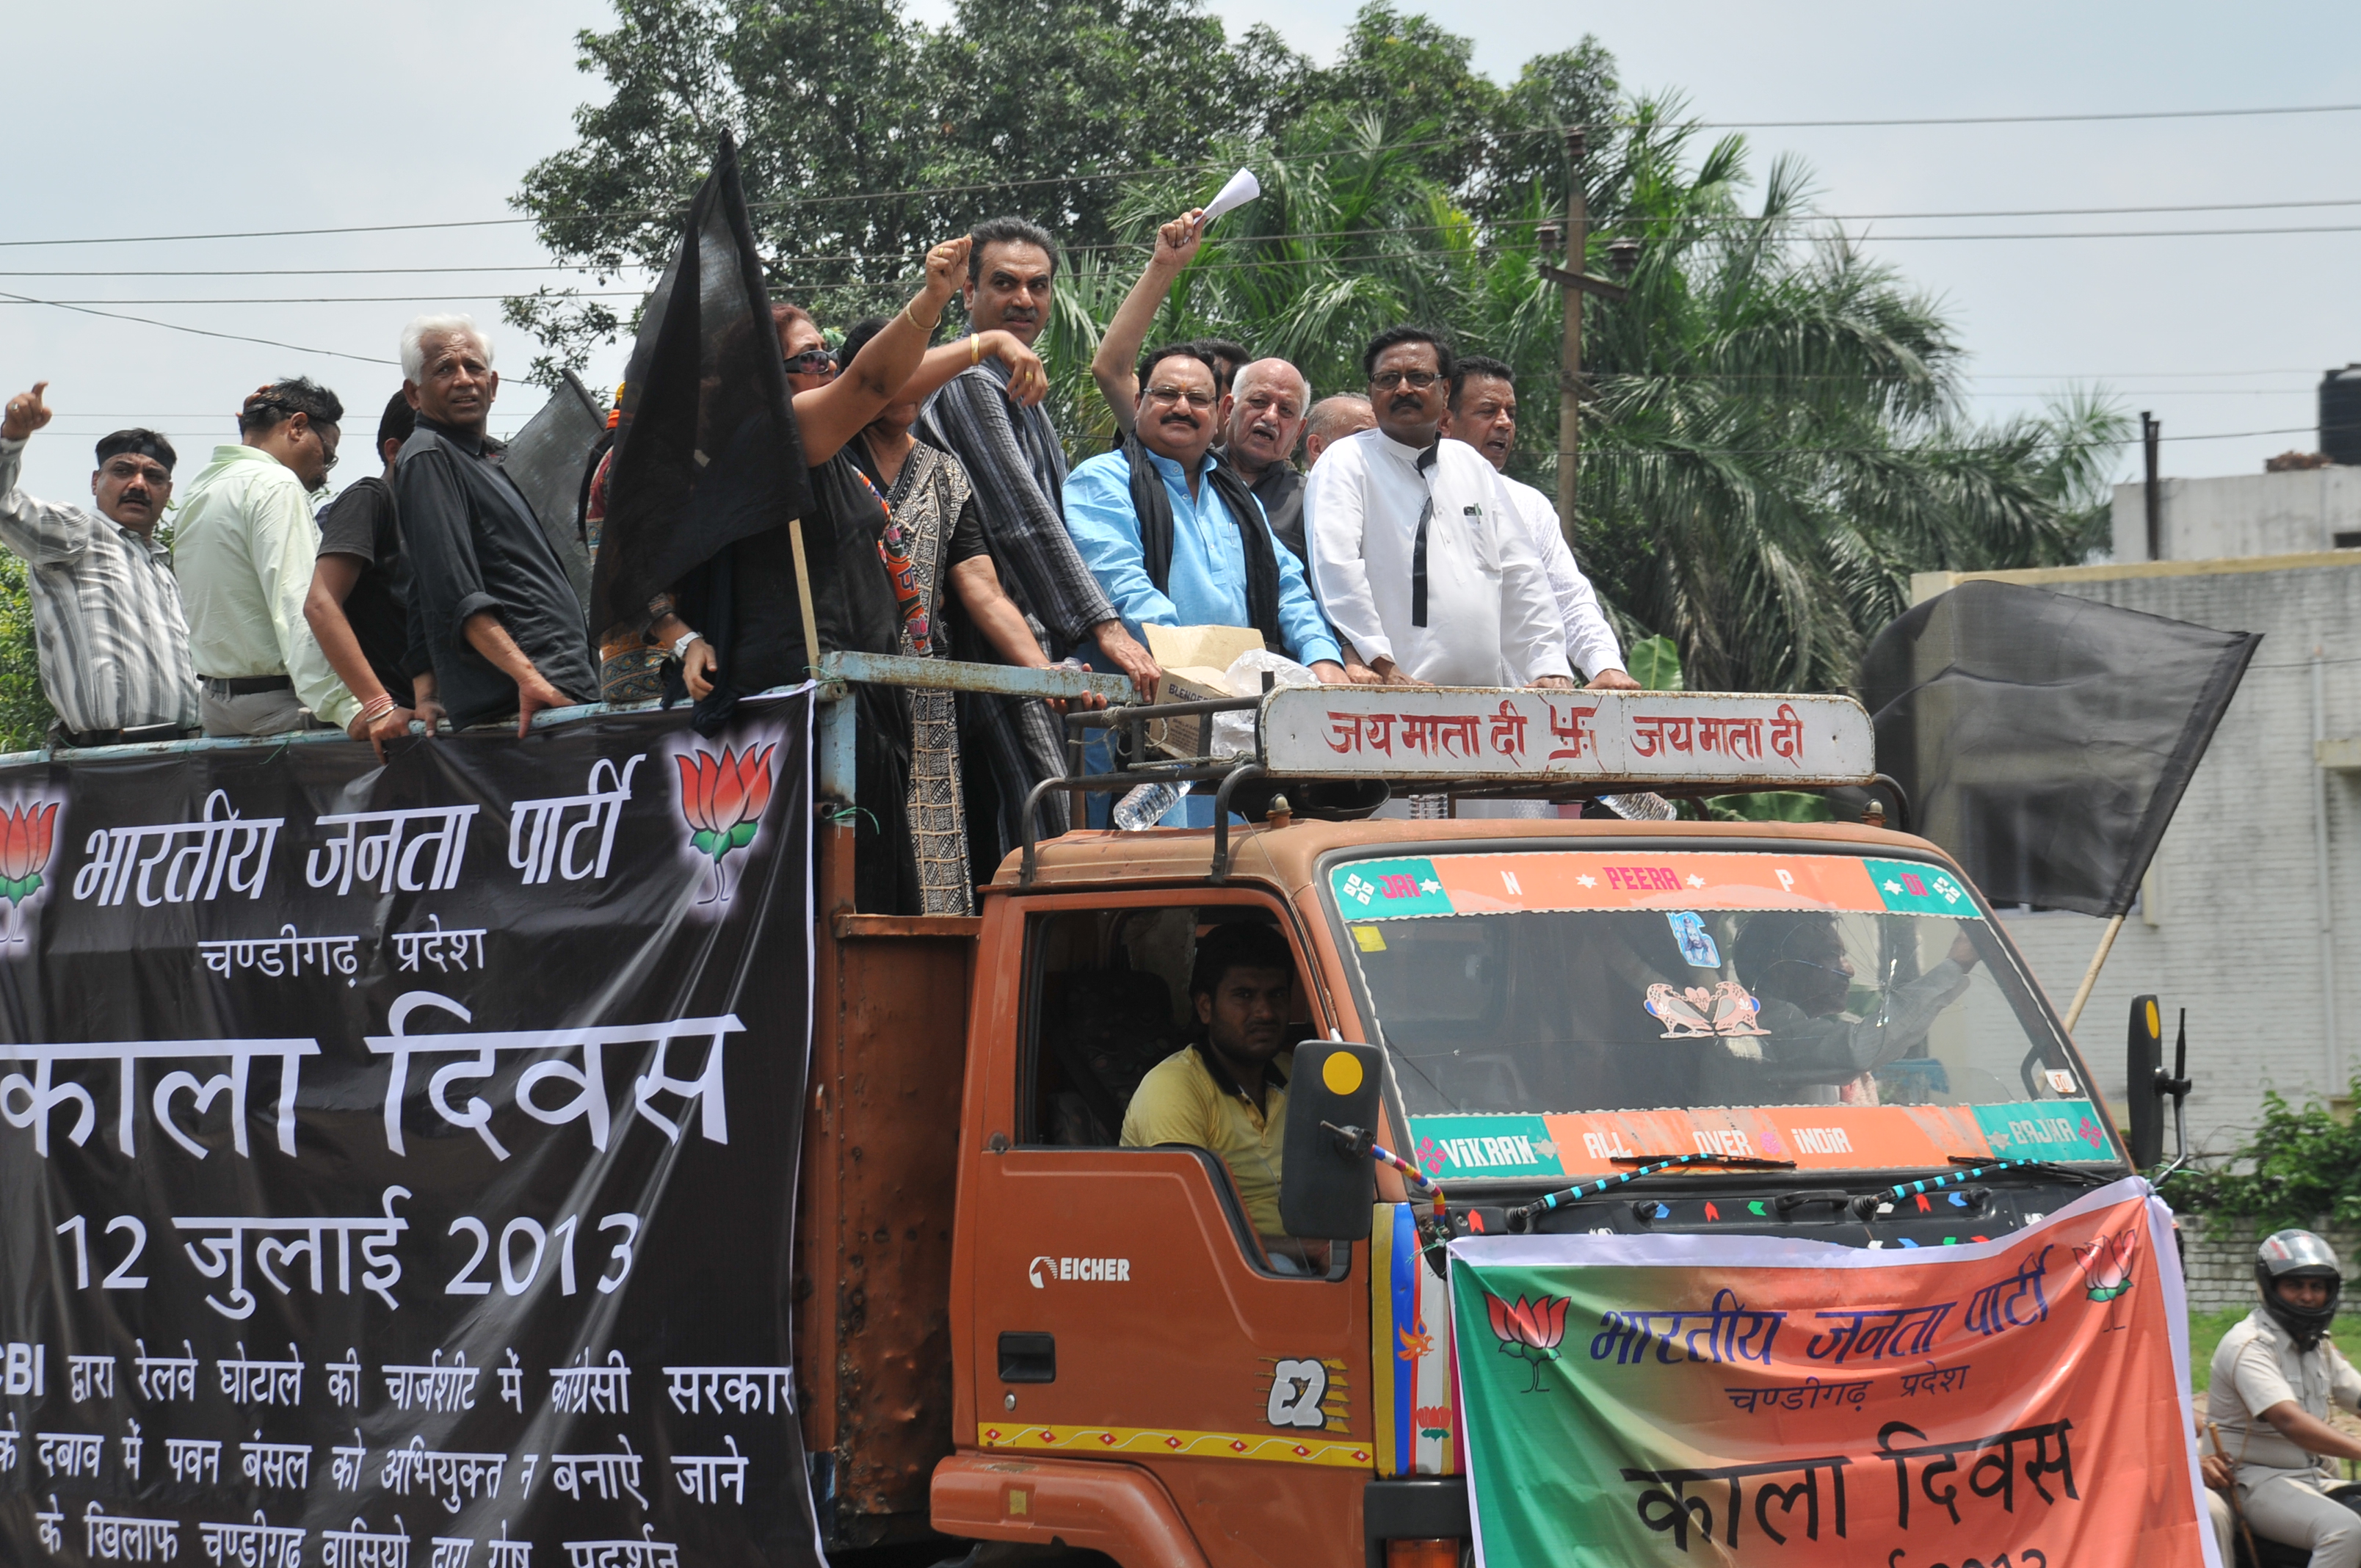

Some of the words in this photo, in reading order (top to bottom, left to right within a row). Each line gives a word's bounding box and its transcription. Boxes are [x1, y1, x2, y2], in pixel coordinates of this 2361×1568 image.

[1323, 711, 1396, 759] जय
[1400, 714, 1481, 760] माता
[1488, 699, 1528, 768] दी
[1629, 716, 1694, 759] जय
[1697, 716, 1765, 761] माता
[1769, 703, 1804, 769] दी
[73, 790, 284, 907] भारतीय
[306, 805, 479, 895] जनता
[509, 755, 646, 884] पार्टी
[1604, 868, 1681, 889] PEERA
[197, 924, 358, 987] चण्डीगढ़
[392, 915, 486, 971] प्रदेश
[0, 1039, 320, 1159] काला
[364, 991, 746, 1161] दिवस
[1584, 1133, 1633, 1158] ALL
[1693, 1130, 1753, 1155] OVER
[57, 1216, 148, 1289] 12
[172, 1186, 411, 1319] जुलाई
[446, 1213, 638, 1296] 2013
[1061, 1258, 1129, 1280] EICHER
[1589, 1288, 1788, 1365] भारतीय
[1806, 1302, 1958, 1365] जनता
[1964, 1244, 2055, 1336] पार्टी
[0, 1343, 43, 1395] BI
[68, 1356, 115, 1402] द्वारा
[135, 1339, 197, 1400] रेलवे
[217, 1342, 304, 1405] घोटाले
[326, 1348, 360, 1407] की
[382, 1349, 479, 1412] चार्जशीट
[498, 1348, 522, 1412] में
[550, 1347, 631, 1413] कांग्रेसी
[663, 1368, 792, 1414] सरकार
[1727, 1376, 1874, 1412] चण्डीगढ़
[1900, 1360, 1971, 1397] प्रदेश
[37, 1434, 104, 1476] दबाव
[122, 1419, 142, 1478] में
[166, 1440, 221, 1483] पवन
[240, 1430, 311, 1488] बंसल
[333, 1428, 366, 1491] को
[381, 1435, 507, 1513] अभियुक्त
[521, 1455, 538, 1500] न
[670, 1435, 749, 1504] जाने
[1619, 1455, 1854, 1553] काला
[1873, 1418, 2080, 1530] दिवस
[36, 1495, 63, 1552] के
[84, 1501, 178, 1561] खिलाफ
